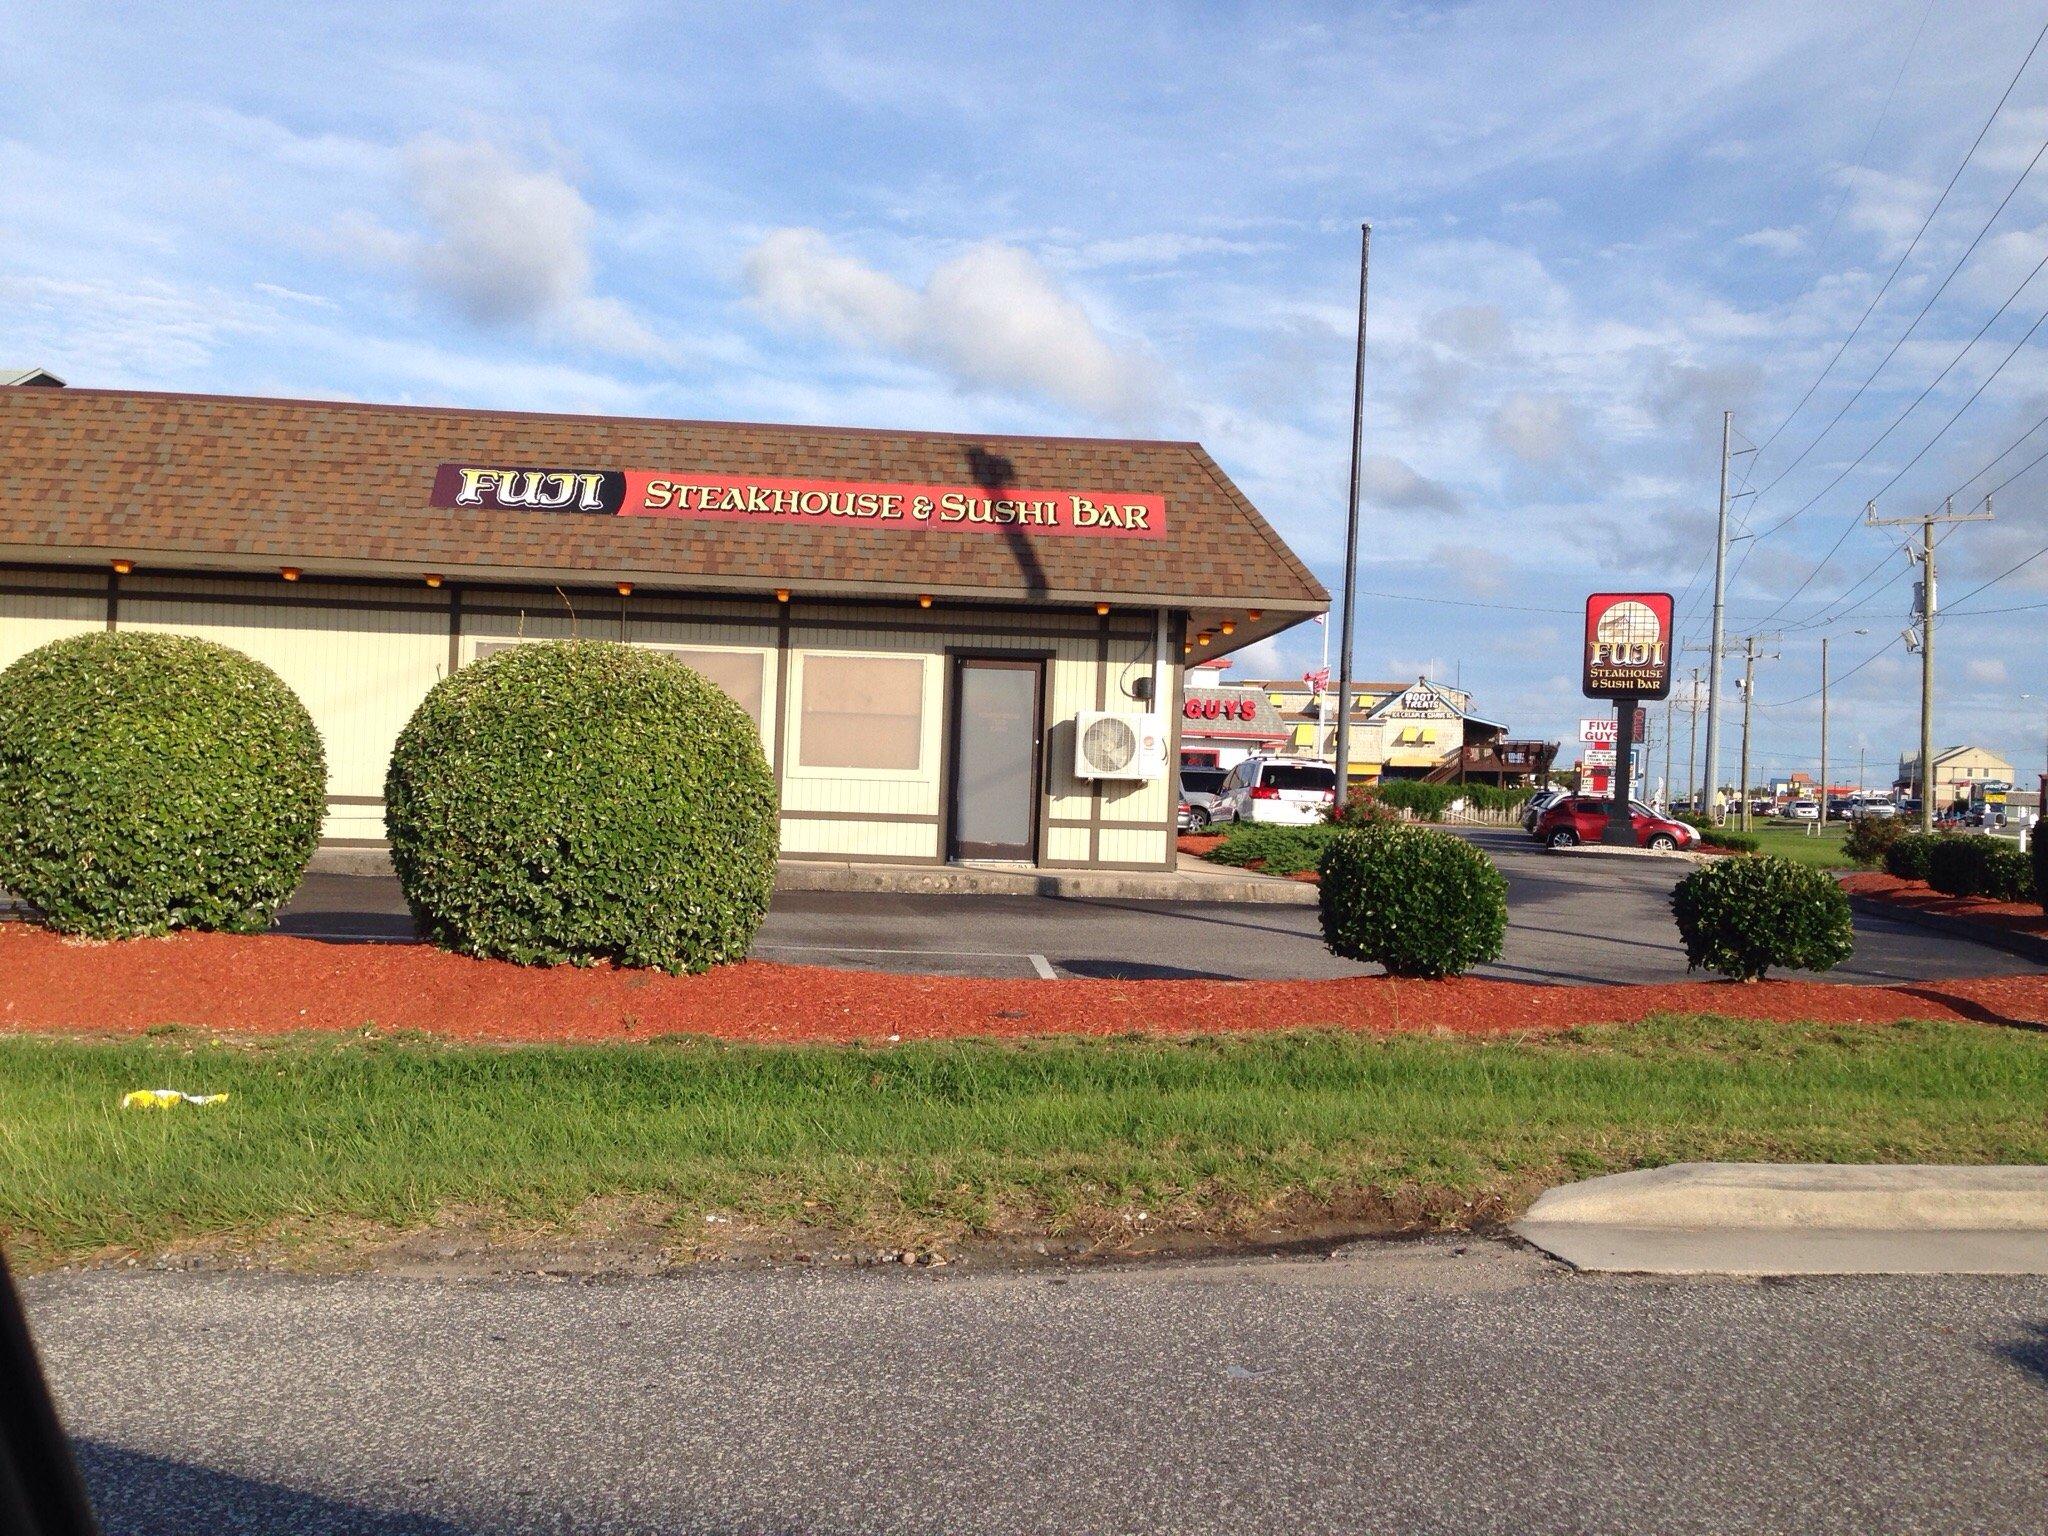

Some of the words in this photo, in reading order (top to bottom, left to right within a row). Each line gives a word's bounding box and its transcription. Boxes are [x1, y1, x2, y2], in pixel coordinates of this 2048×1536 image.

[456, 467, 606, 511] FUJI
[644, 480, 904, 519] STEAKHOUSE
[912, 495, 934, 521] &
[939, 493, 1059, 526] SUSHI
[1069, 495, 1150, 530] BAR
[1590, 641, 1665, 668] FUJI
[1590, 667, 1663, 678] STEAKHOUSE
[1592, 679, 1600, 689] &
[1600, 678, 1634, 689] SUSHI
[1637, 678, 1661, 690] BAR
[1183, 698, 1257, 721] GUYS
[1404, 700, 1440, 709] TREATS
[1588, 721, 1618, 731] FIVE
